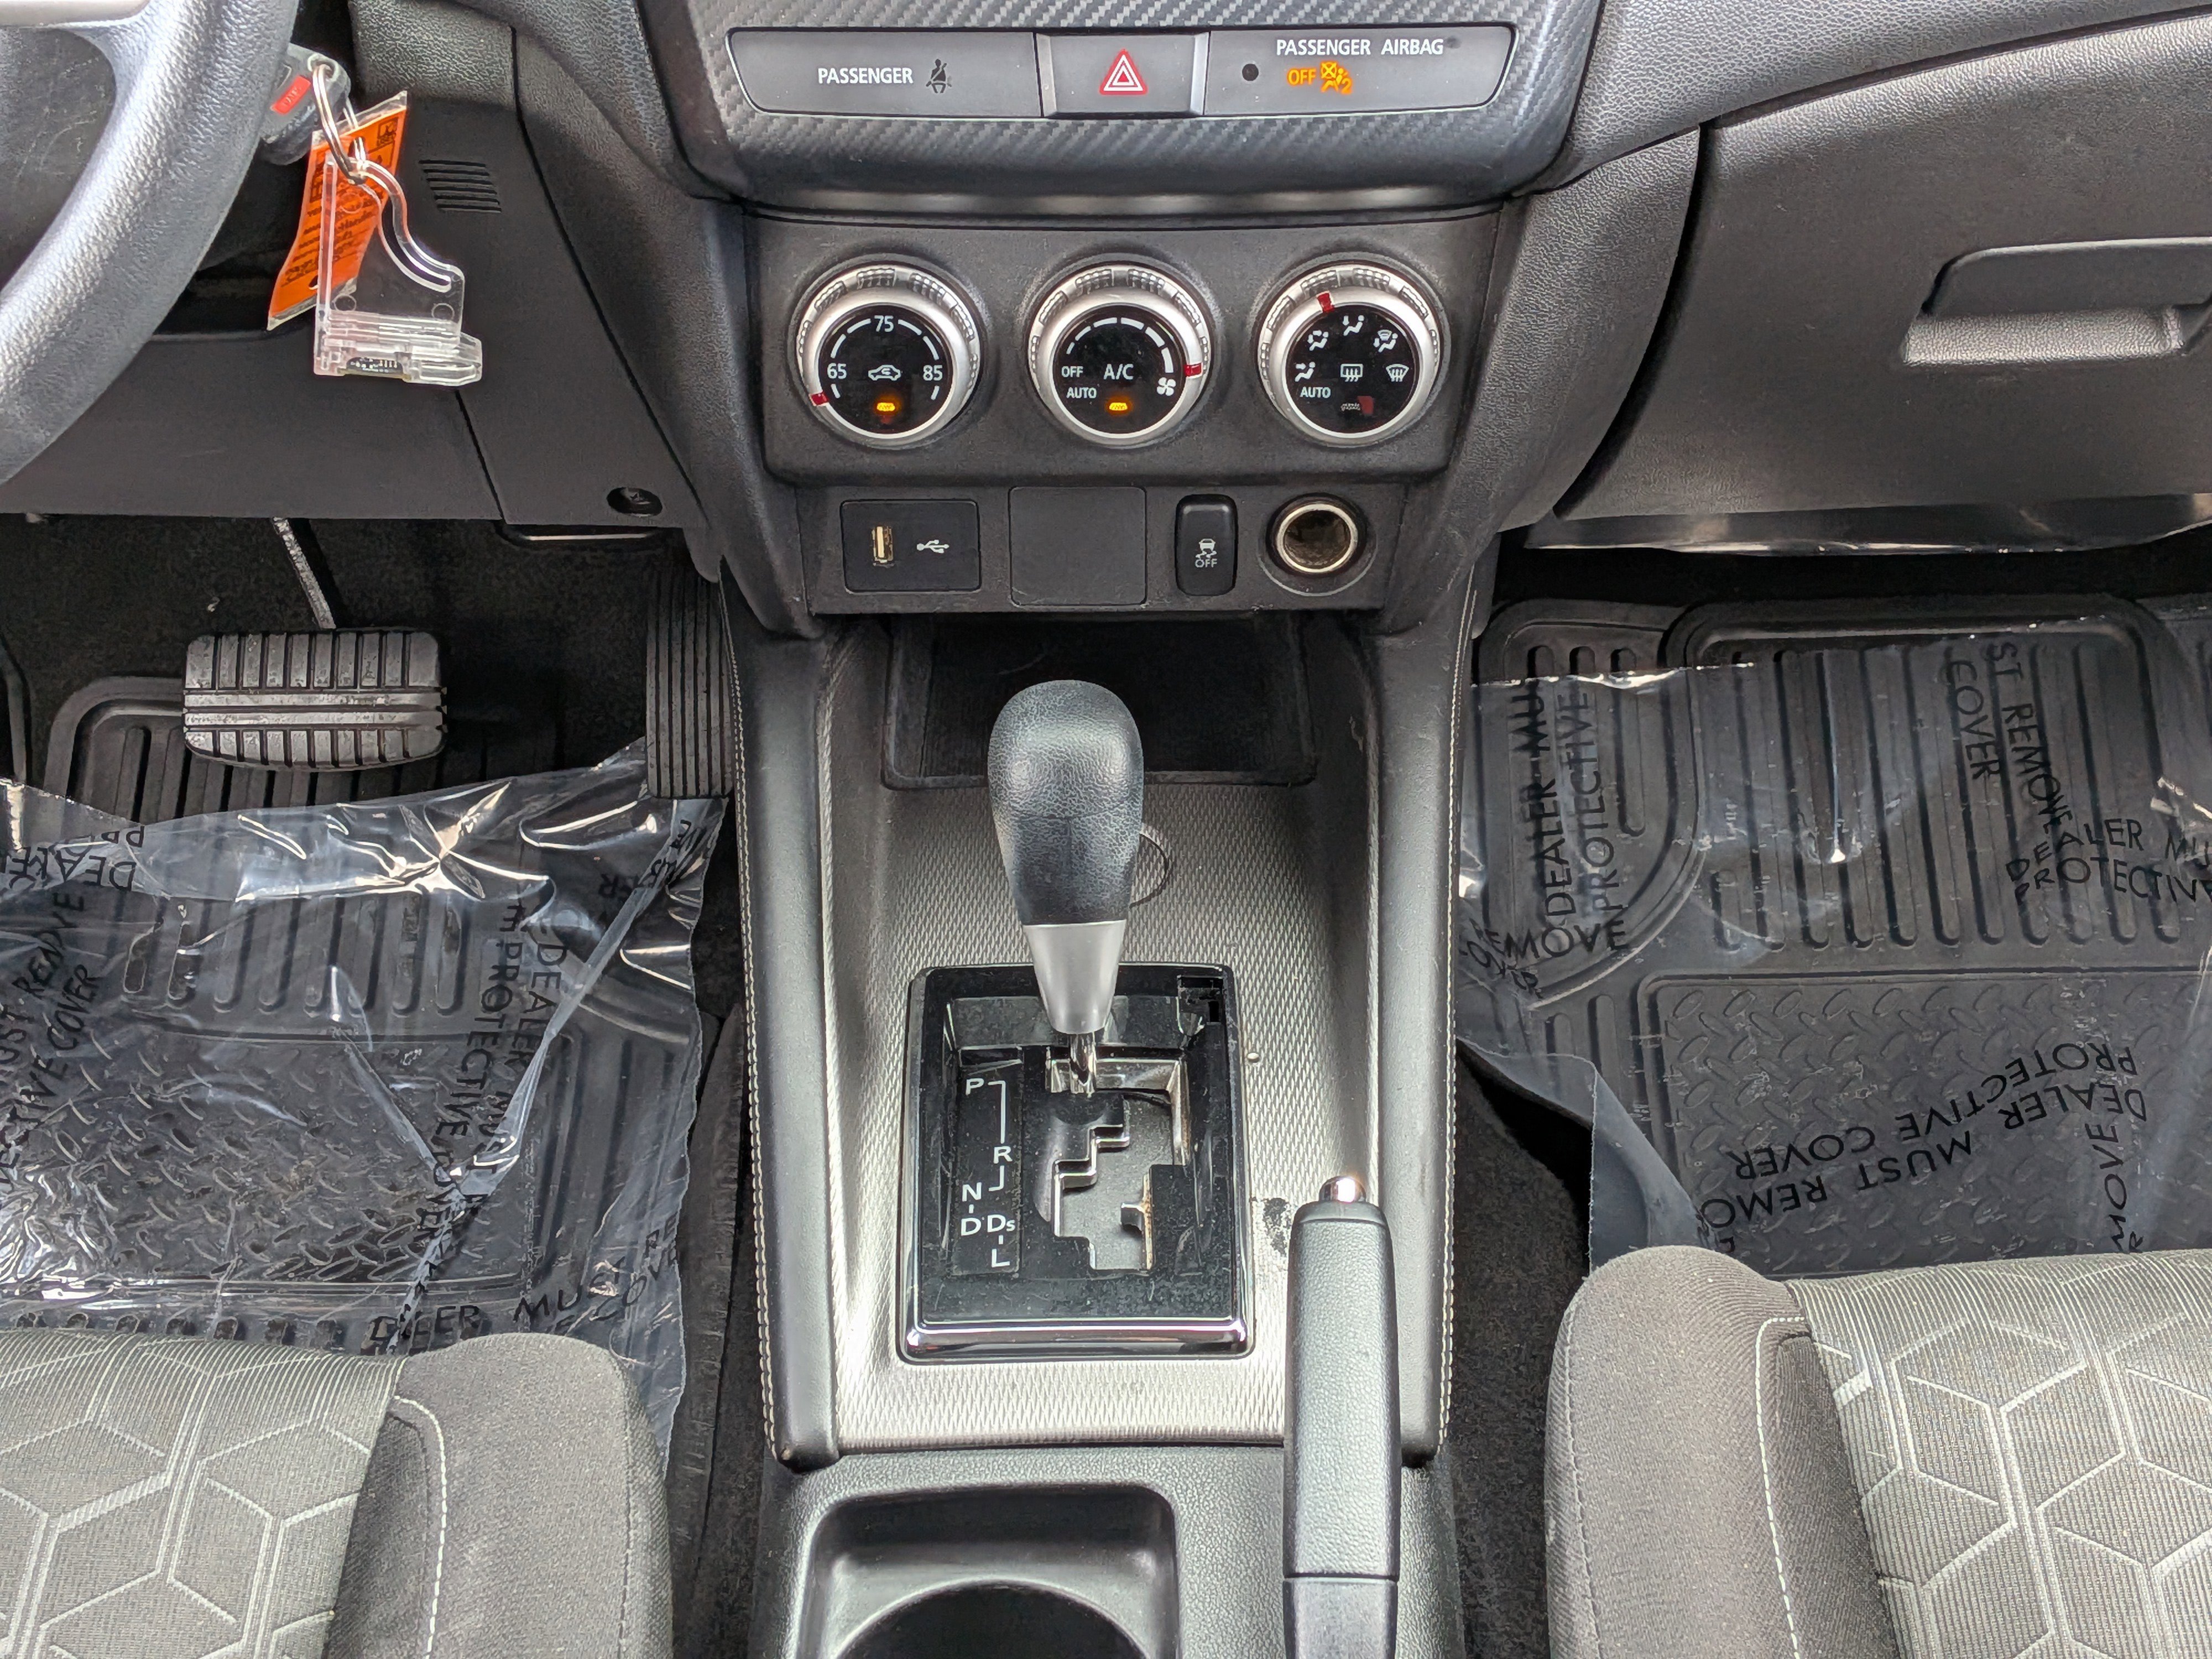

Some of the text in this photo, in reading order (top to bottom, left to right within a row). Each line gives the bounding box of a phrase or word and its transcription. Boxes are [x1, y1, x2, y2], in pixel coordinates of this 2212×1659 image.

[1276, 38, 1444, 56] PASSENGER AIRBAG
[817, 67, 914, 85] PASSENGER
[1287, 67, 1317, 86] OFF
[874, 315, 894, 332] 75
[827, 363, 847, 379] 65
[922, 364, 943, 382] 85
[1061, 366, 1084, 378] OFF
[1103, 363, 1134, 380] A/C
[1066, 387, 1097, 399] AUTO
[1300, 386, 1332, 399] AUTO
[1194, 557, 1218, 568] OFF
[1945, 660, 2001, 780] COVER
[2002, 702, 2074, 834] REMOVE
[1556, 692, 1625, 912] PROTECTIVE
[2005, 818, 2145, 884] DEALER
[47, 963, 100, 1051] COVER
[436, 942, 523, 1136] PROTECTIVE
[965, 1078, 985, 1096] P
[1728, 1041, 2138, 1182] PROTECTIVE COVER
[1996, 1082, 2147, 1130] DEALER
[993, 1146, 1013, 1164] R
[1856, 1130, 1972, 1191] MUST
[962, 1182, 982, 1202] N
[961, 1217, 982, 1236] D
[991, 1248, 1011, 1268] L
